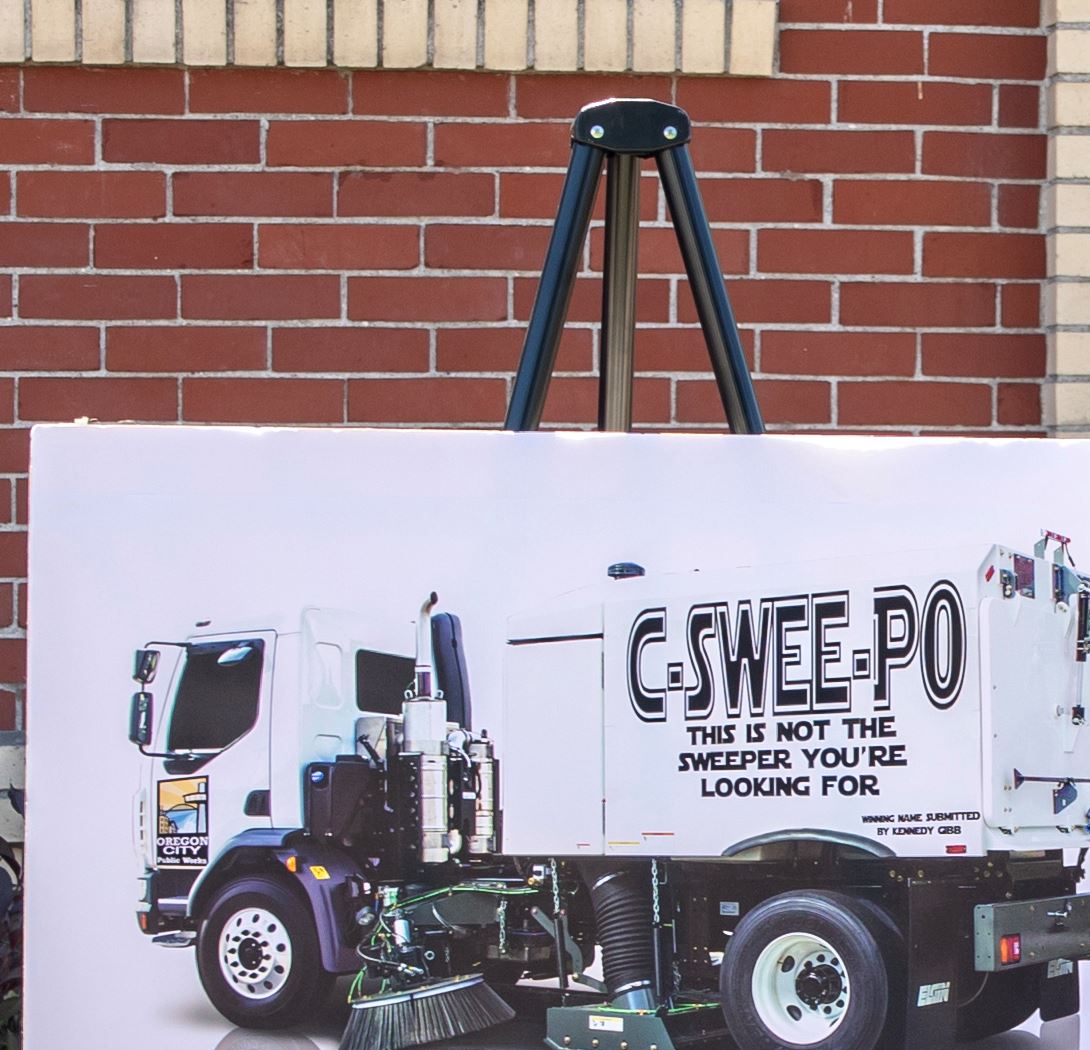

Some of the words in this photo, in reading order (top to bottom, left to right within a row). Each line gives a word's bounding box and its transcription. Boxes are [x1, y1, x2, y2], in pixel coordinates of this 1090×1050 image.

[627, 579, 967, 722] C-SWEE-PO
[686, 724, 736, 745] THIS
[746, 723, 766, 743] IS
[776, 720, 831, 742] NOT
[842, 716, 897, 739] THE
[678, 749, 792, 771] SWEEPER
[801, 745, 907, 769] YOU'RE
[701, 774, 810, 797] LOOKING
[822, 774, 880, 796] FOR
[861, 815, 895, 823] WINNING
[898, 814, 922, 822] NAME
[926, 811, 980, 822] SUBMITTED
[877, 827, 889, 836] BY
[892, 826, 934, 836] KENNEDY
[938, 826, 961, 835] GIBB
[157, 836, 208, 846] OREGON
[163, 846, 201, 855] CITY
